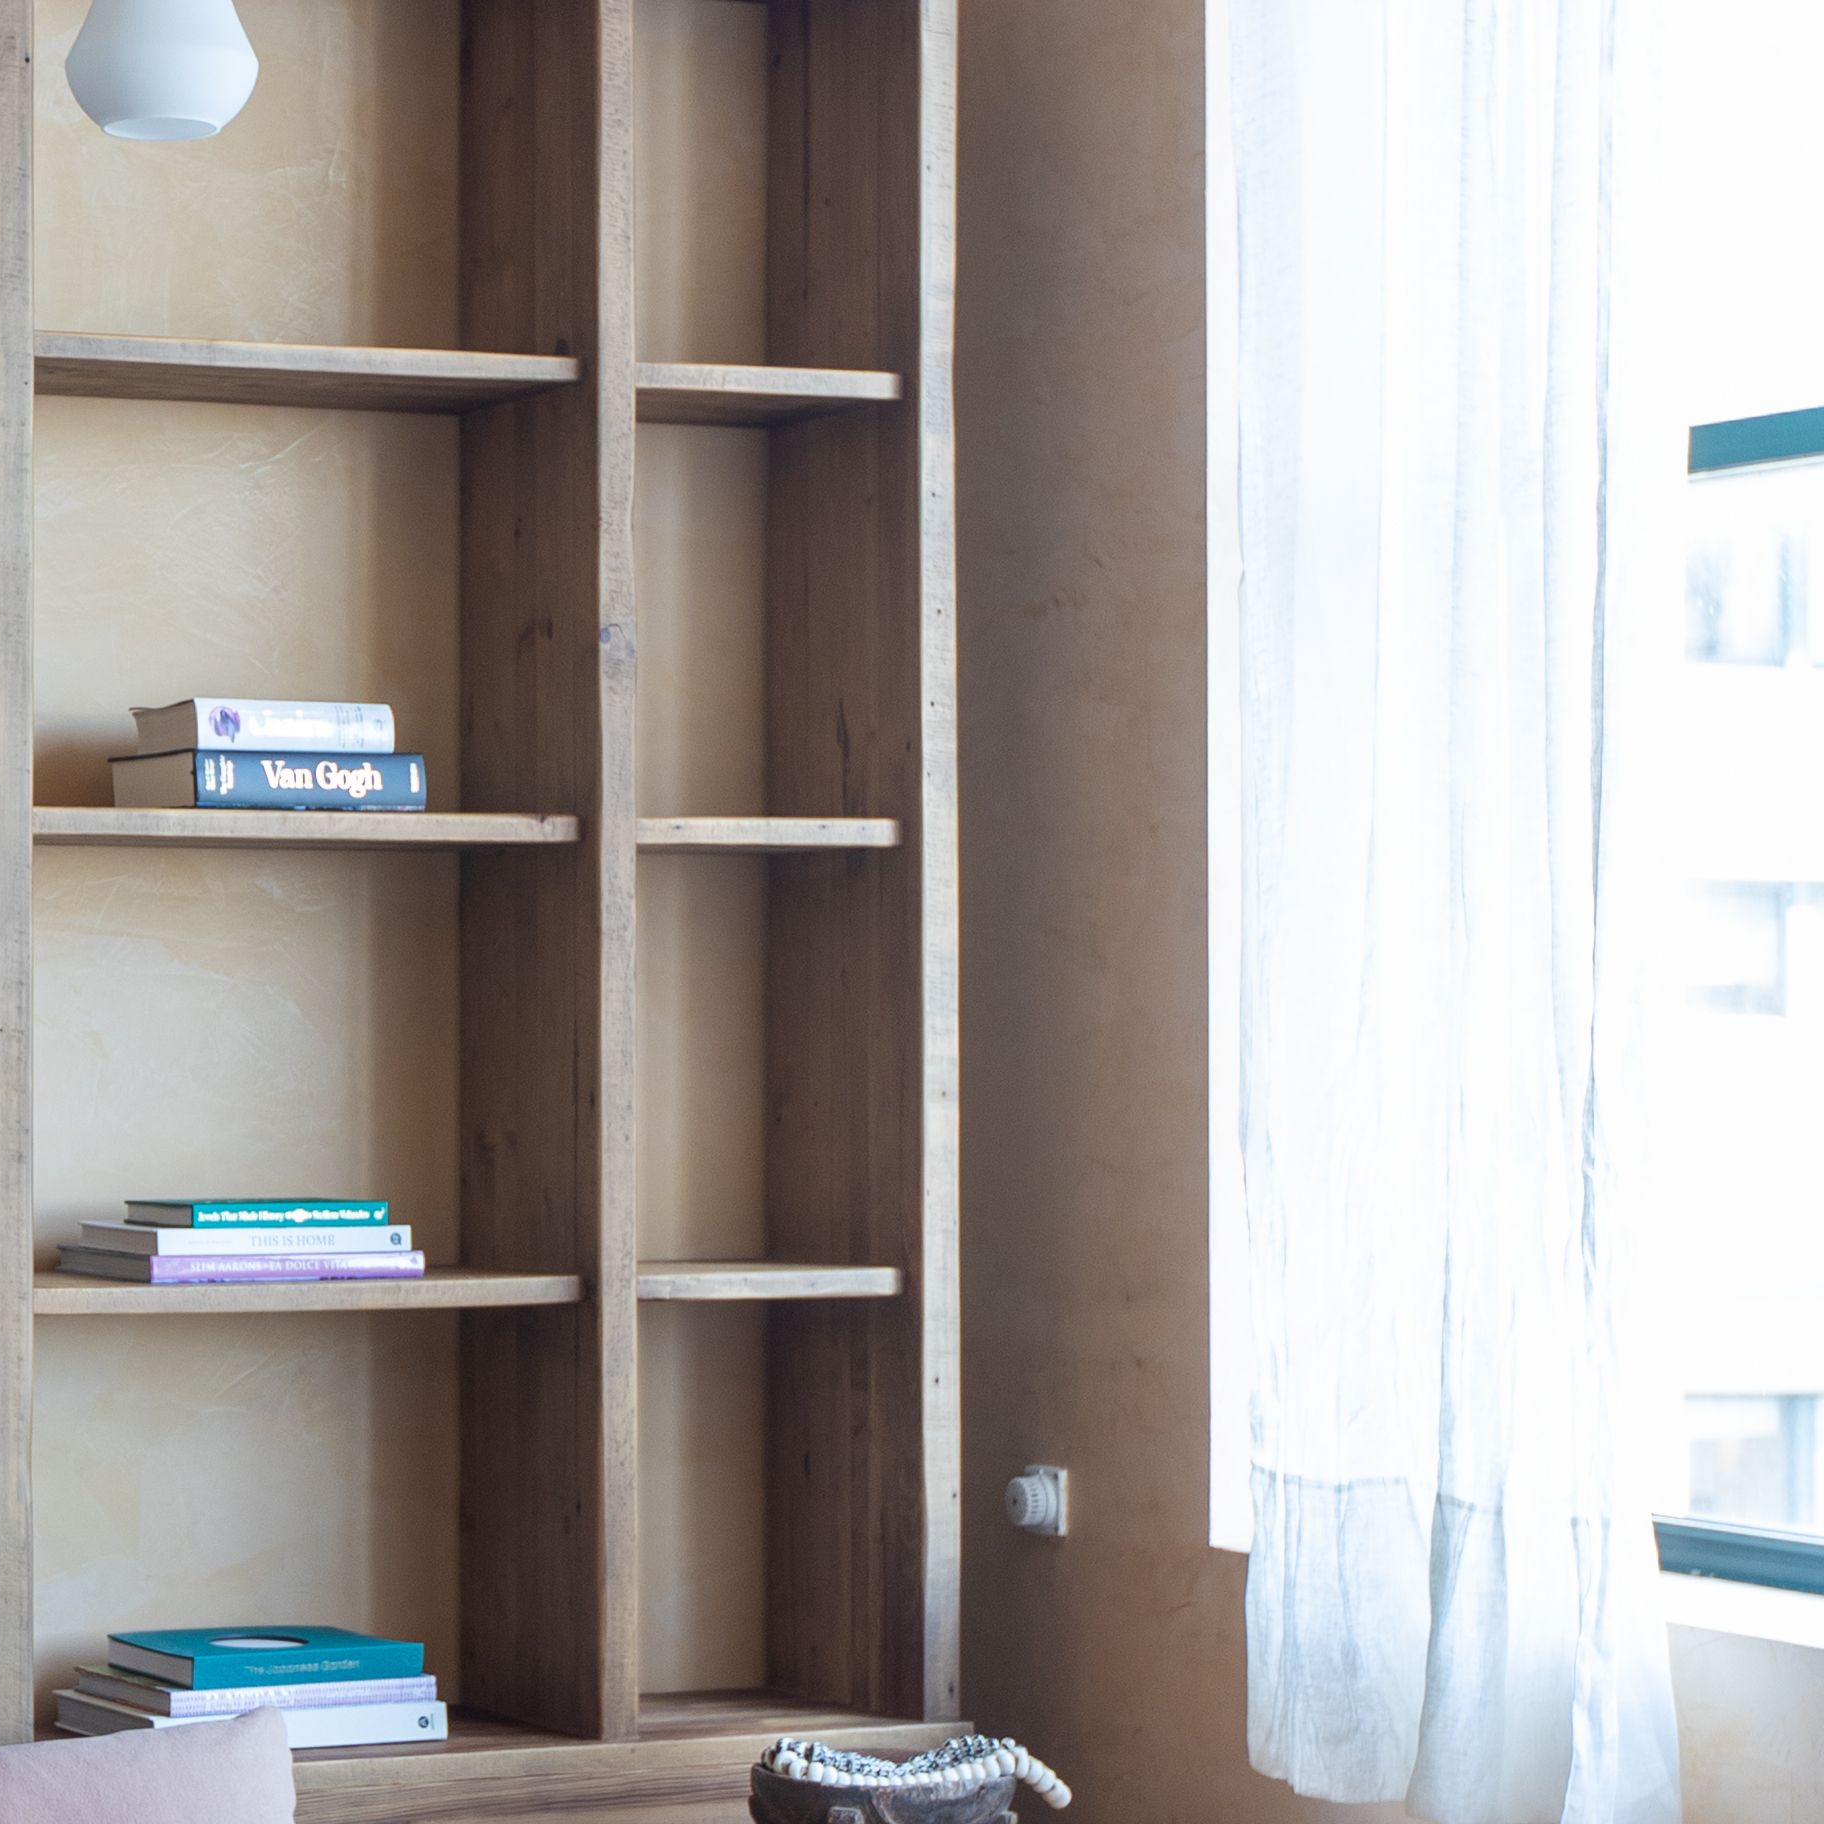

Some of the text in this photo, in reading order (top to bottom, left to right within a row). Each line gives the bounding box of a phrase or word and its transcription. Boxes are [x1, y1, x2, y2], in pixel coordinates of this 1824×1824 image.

[261, 759, 315, 790] Van
[316, 761, 383, 798] Gogh
[249, 1234, 279, 1248] THIS
[282, 1234, 294, 1247] IS
[296, 1233, 336, 1247] HOME
